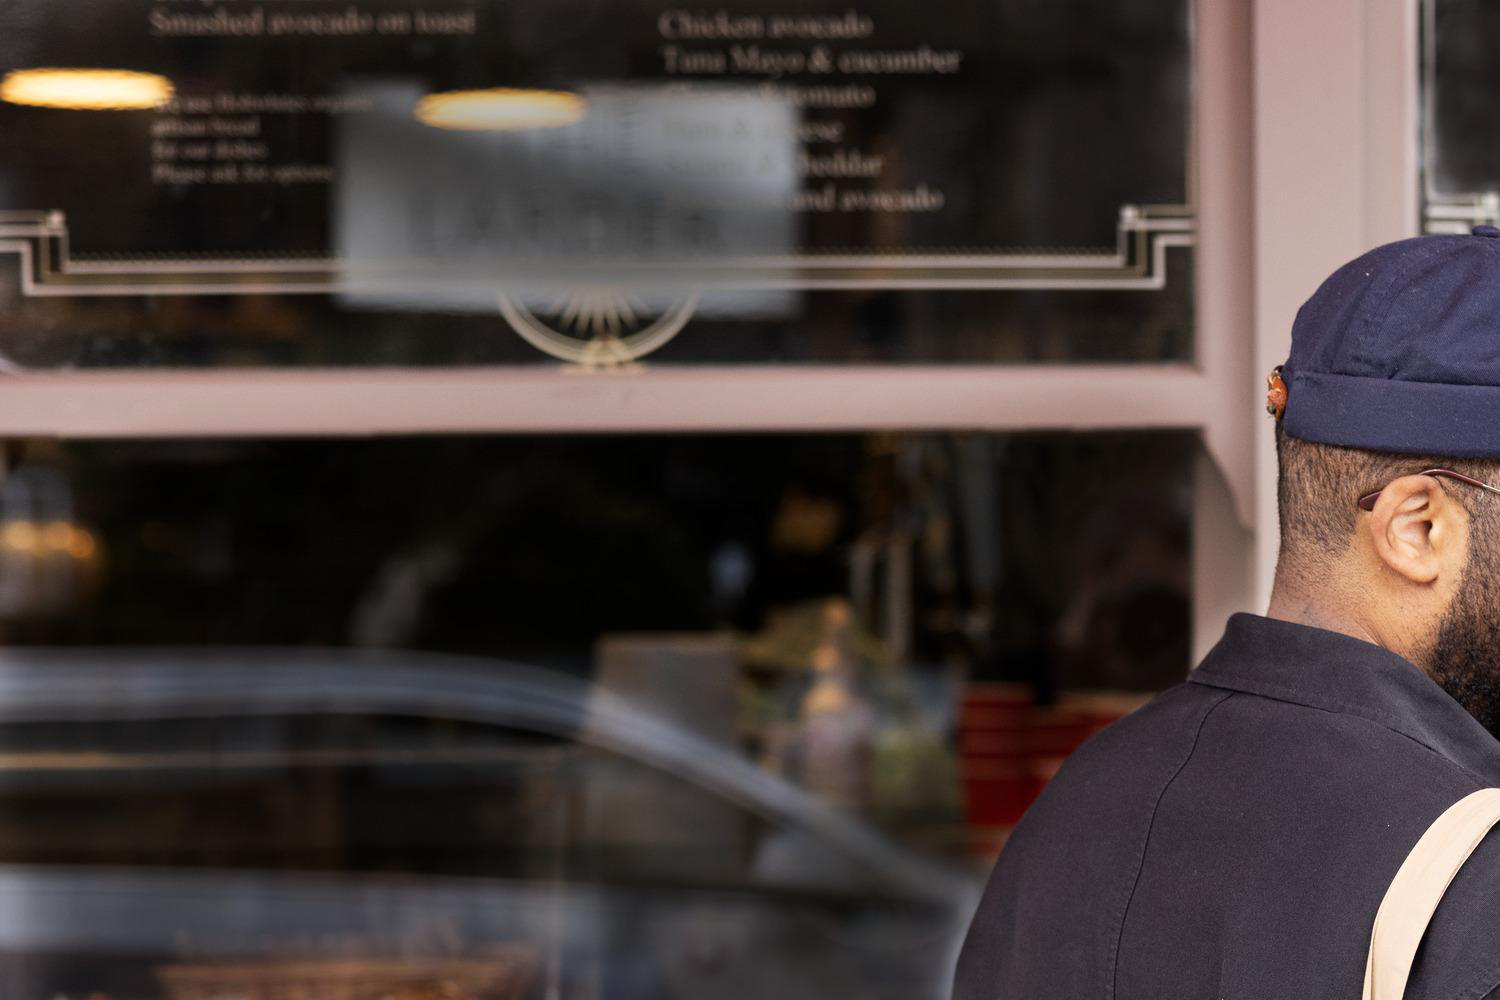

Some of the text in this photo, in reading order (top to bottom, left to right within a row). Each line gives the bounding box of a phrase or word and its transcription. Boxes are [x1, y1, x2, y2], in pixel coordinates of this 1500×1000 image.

[149, 8, 476, 36] Smashed avocado on toast
[658, 8, 874, 39] Chicken avocado
[661, 43, 962, 79] Tuna Mayo & cucumber
[839, 182, 946, 212] avocado
